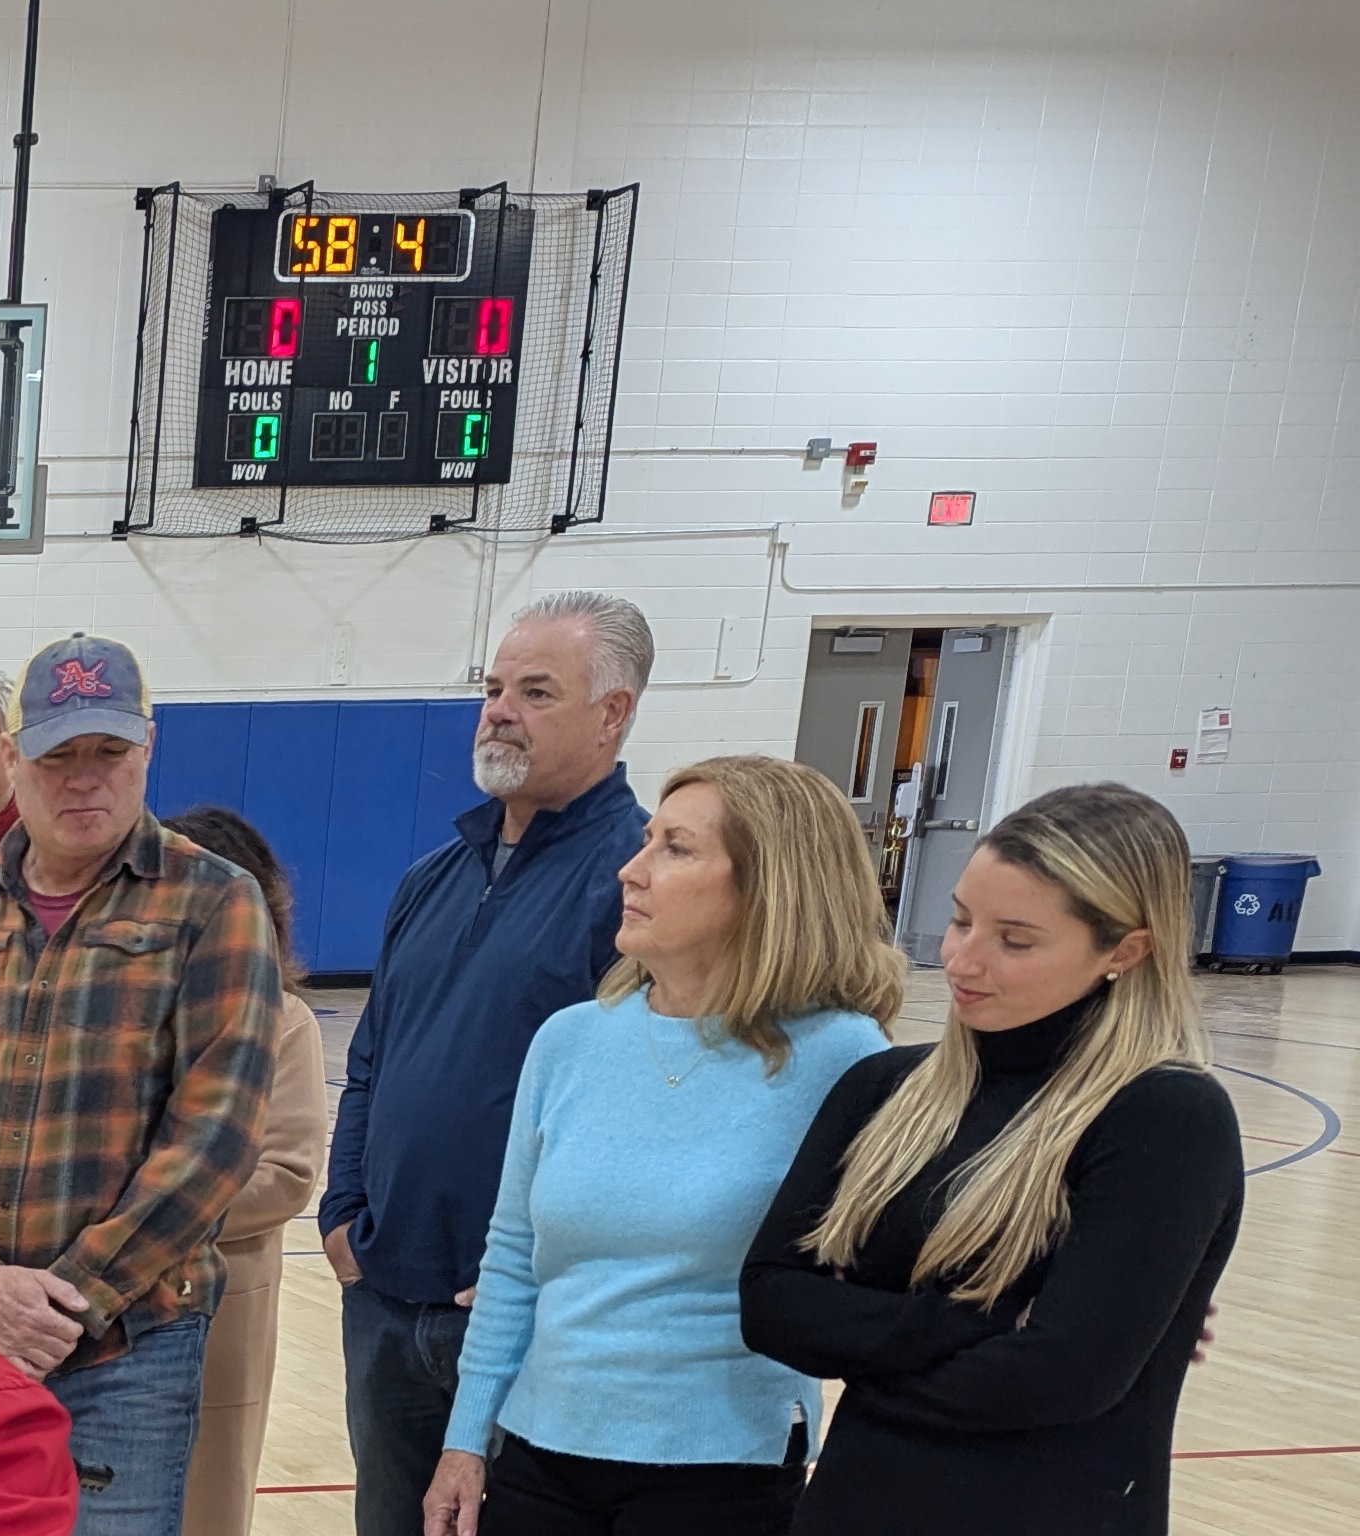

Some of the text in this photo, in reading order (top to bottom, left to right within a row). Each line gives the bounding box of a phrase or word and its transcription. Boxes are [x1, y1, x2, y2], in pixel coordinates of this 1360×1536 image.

[349, 284, 394, 298] BONUS
[353, 300, 388, 316] POSS
[336, 317, 400, 336] PERIOD
[367, 341, 378, 383] 1
[225, 360, 294, 386] HOME
[229, 391, 282, 411] FOULS
[329, 391, 353, 411] NO
[389, 390, 401, 410] F
[254, 416, 279, 459] 0
[232, 463, 268, 481] WON
[440, 462, 476, 479] WON
